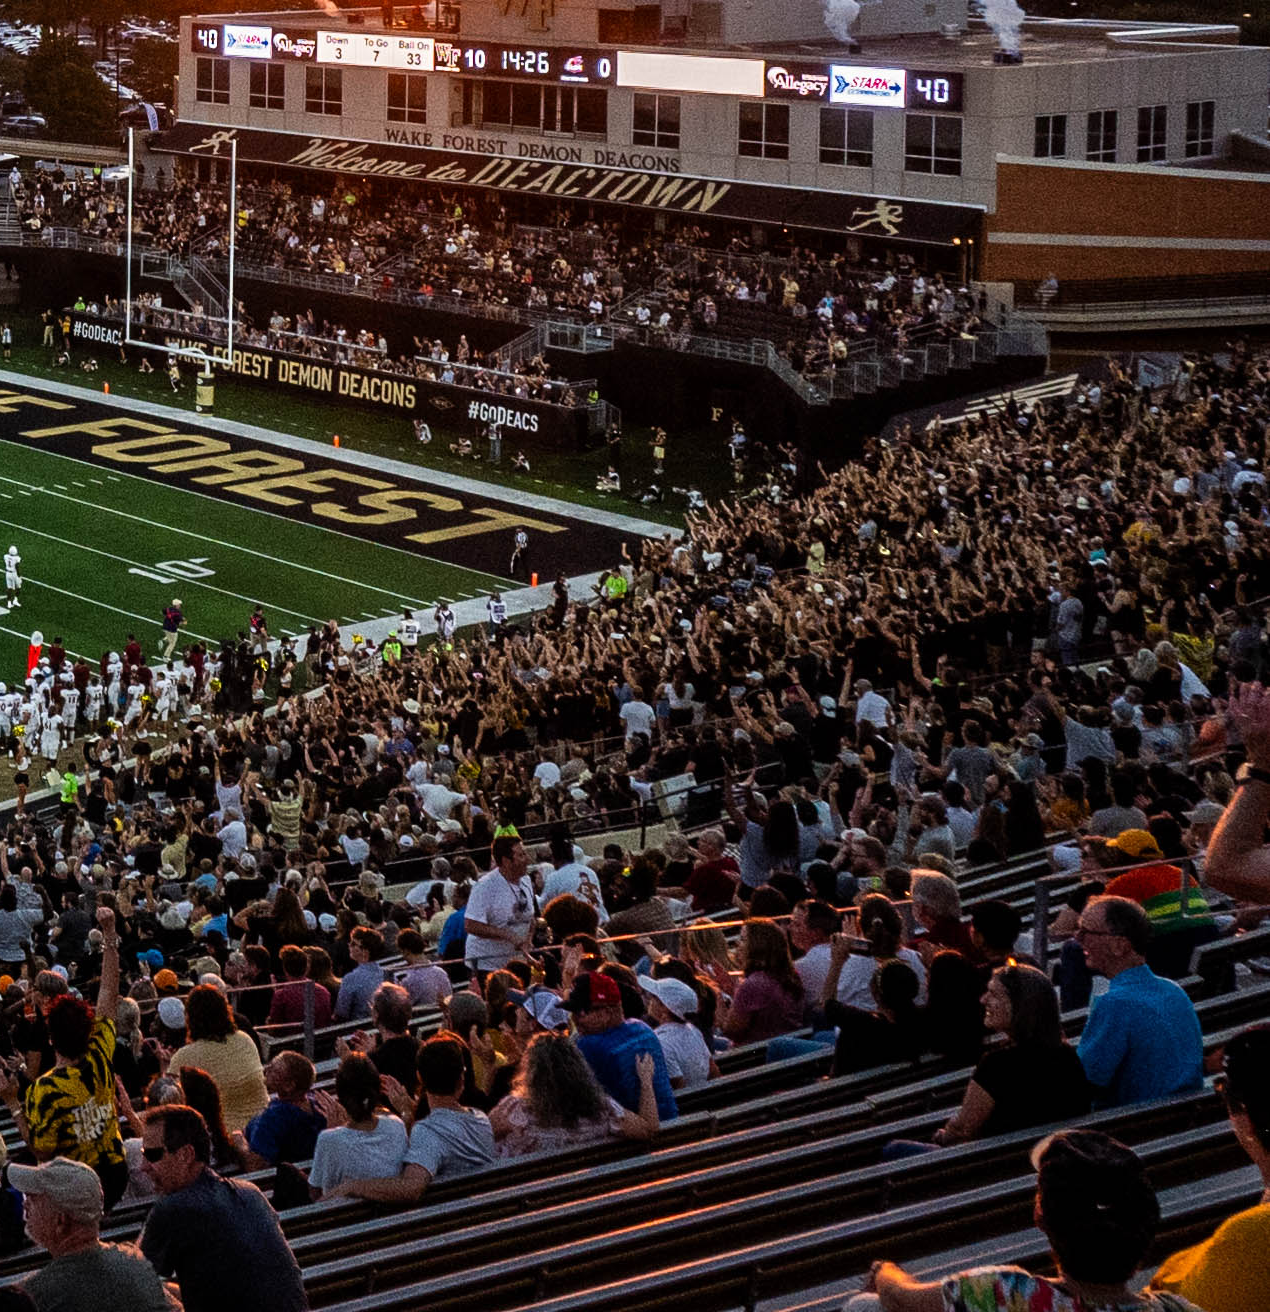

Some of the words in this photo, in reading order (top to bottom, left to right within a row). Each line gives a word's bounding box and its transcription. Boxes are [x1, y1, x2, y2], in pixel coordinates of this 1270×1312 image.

[197, 29, 218, 49] 40
[275, 35, 316, 57] Allegacy
[326, 35, 349, 45] Down
[364, 38, 374, 47] To
[376, 39, 388, 48] Go
[399, 40, 414, 49] Ball
[417, 42, 429, 50] On
[335, 47, 342, 59] 3
[373, 50, 379, 62] 7
[406, 52, 421, 66] 33
[464, 48, 486, 69] 10
[502, 50, 549, 74] 14:26
[598, 58, 611, 78] 0
[771, 70, 828, 97] Allegacy
[850, 75, 889, 90] STARK
[916, 78, 949, 103] 40
[385, 128, 433, 147] WAKE
[443, 134, 508, 156] FOREST
[518, 143, 583, 163] DEMON
[594, 150, 681, 173] DEACONS
[286, 138, 427, 180] Welcome
[426, 160, 468, 181] to
[469, 158, 732, 212] DEACTOWN
[212, 346, 271, 379] FOREST
[278, 359, 329, 390] DEMON
[338, 372, 417, 409] DEACONS
[467, 400, 540, 432] #GODEACS
[711, 407, 723, 422] F
[19, 414, 571, 545] FOREST
[127, 559, 217, 586] 10
